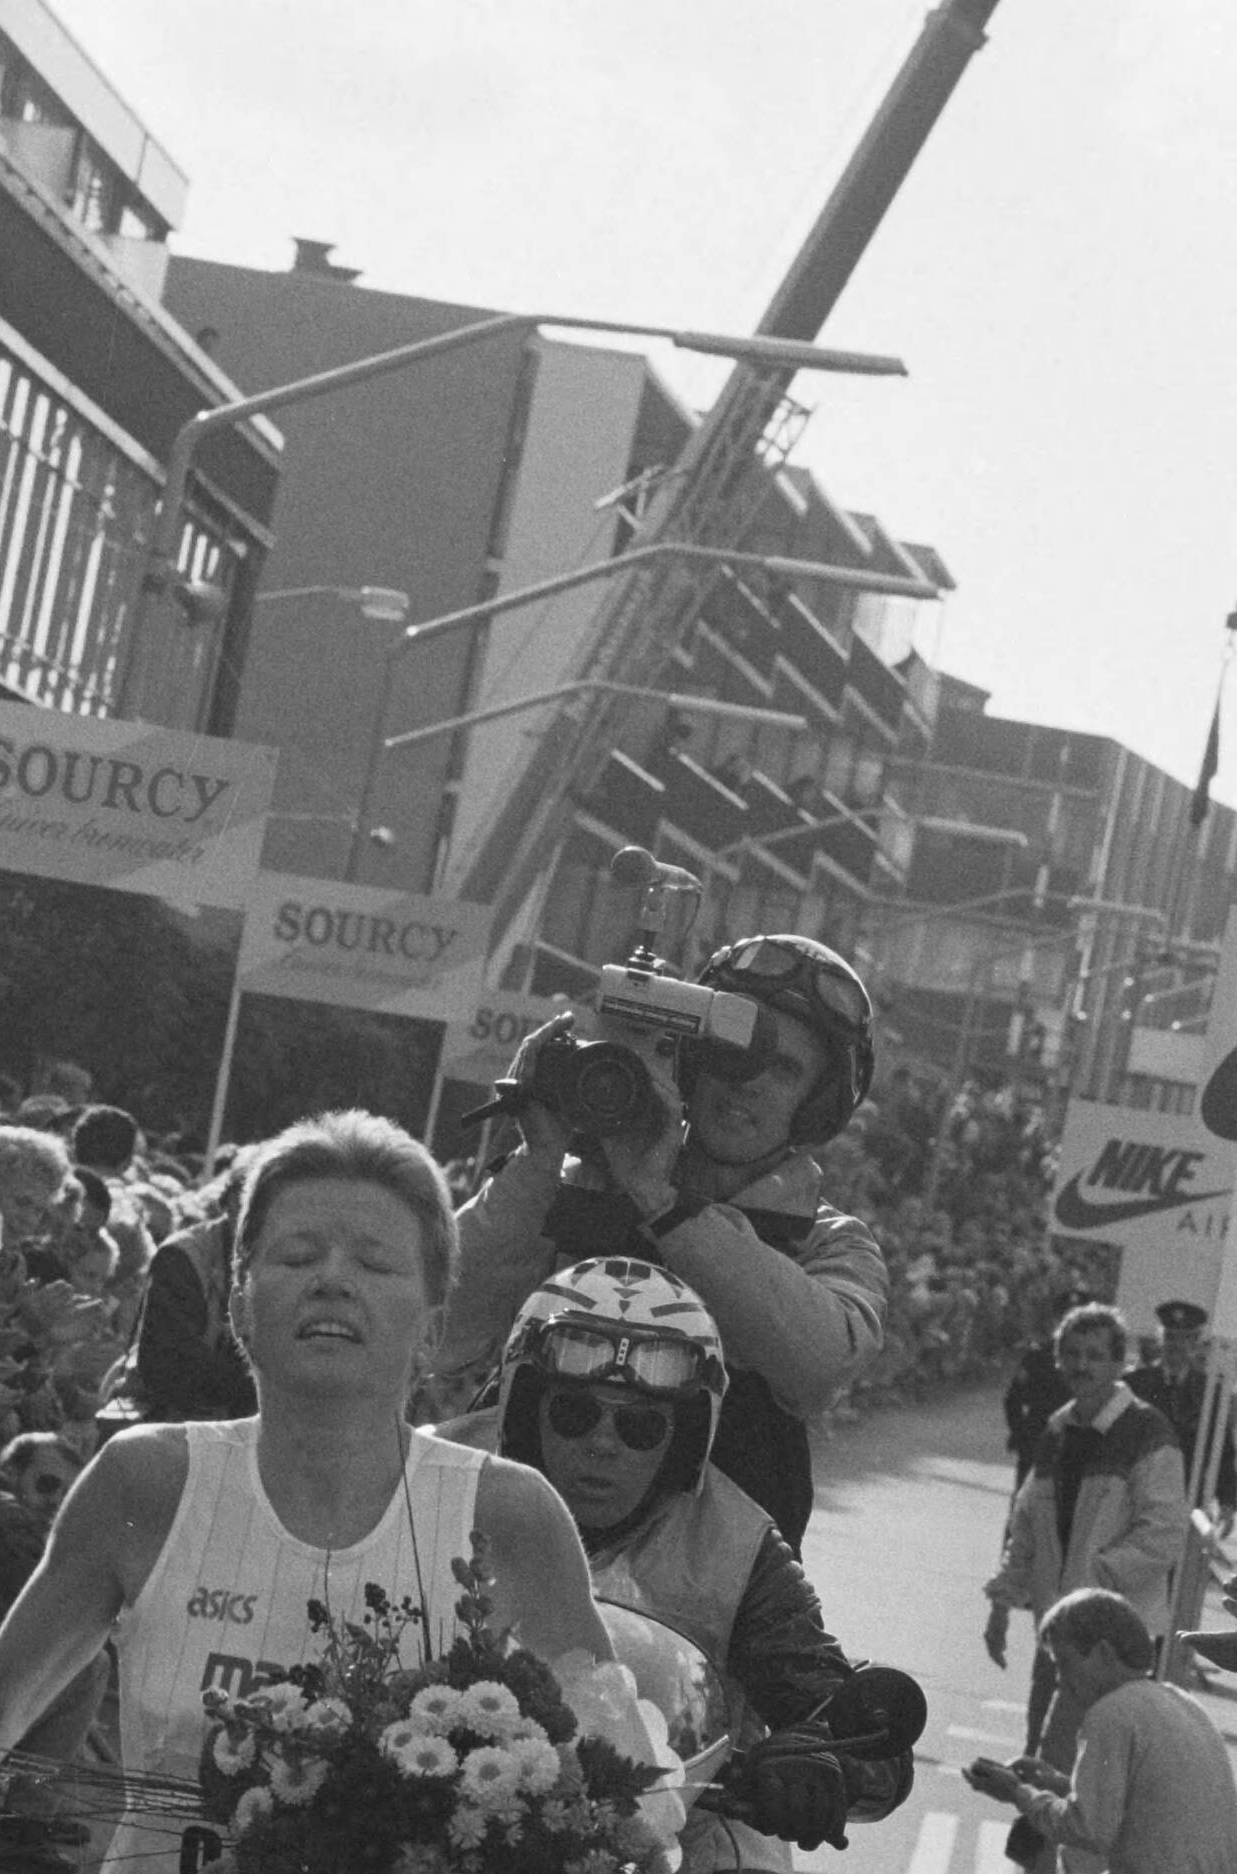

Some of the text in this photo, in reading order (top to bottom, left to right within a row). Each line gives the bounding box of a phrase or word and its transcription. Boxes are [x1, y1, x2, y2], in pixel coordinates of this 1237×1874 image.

[273, 902, 458, 962] SOURCY
[1086, 1138, 1205, 1197] NIKE
[187, 1586, 258, 1625] asics
